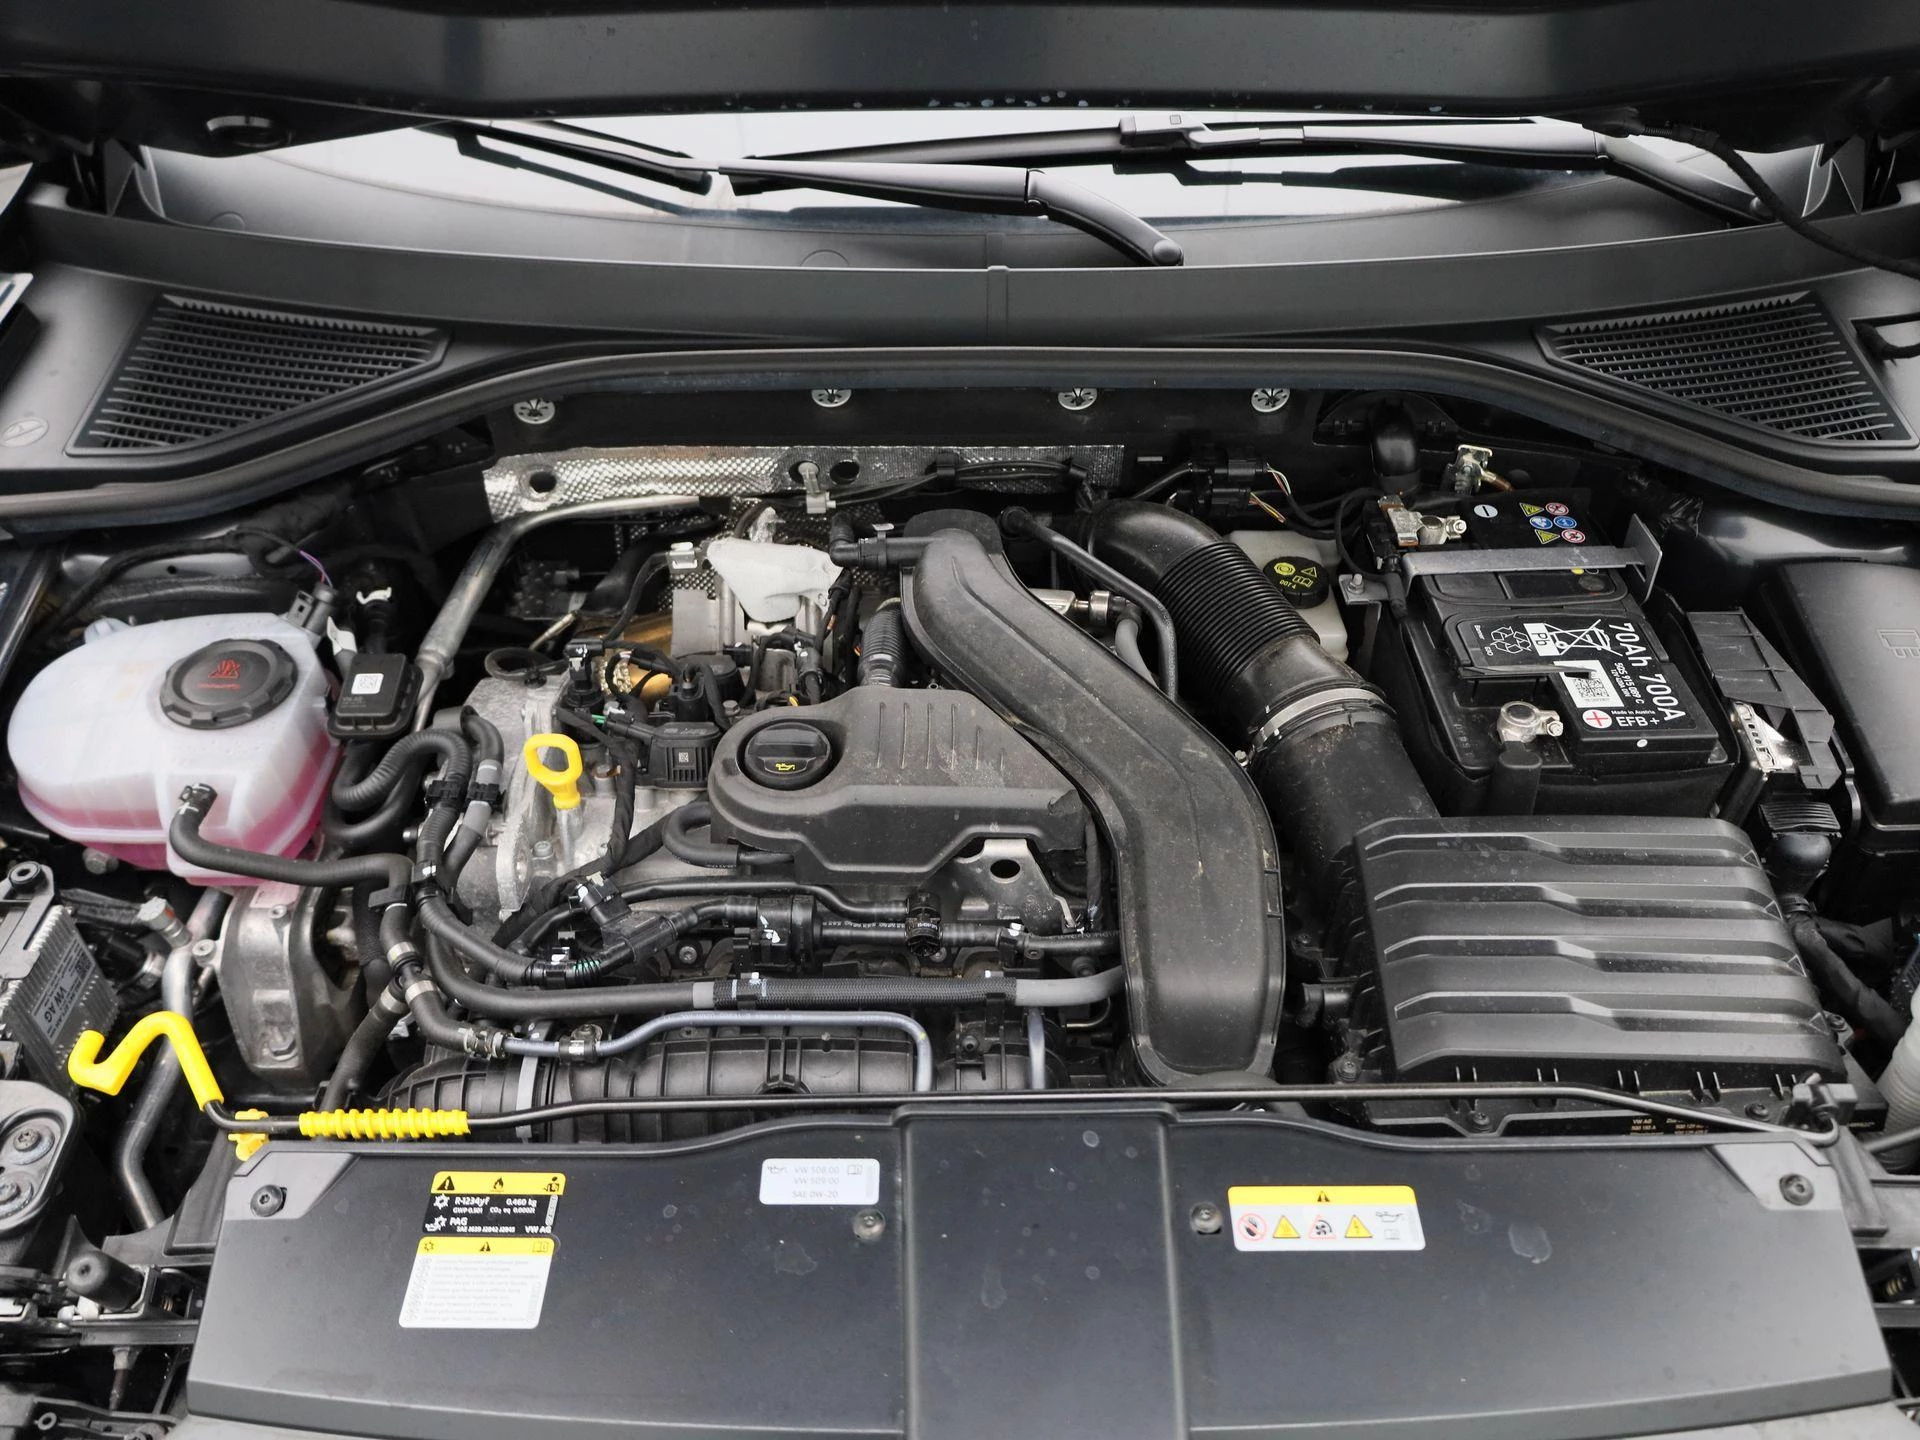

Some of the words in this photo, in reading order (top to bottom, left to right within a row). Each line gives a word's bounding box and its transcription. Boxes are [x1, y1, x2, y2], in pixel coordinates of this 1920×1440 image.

[1531, 632, 1551, 645] Pb
[1608, 622, 1653, 667] 70Ah
[1638, 673, 1686, 721] 700A
[1621, 675, 1635, 686] 915
[1615, 716, 1649, 727] EFB
[53, 986, 67, 1007] VW
[44, 1001, 57, 1023] AG
[454, 1196, 491, 1207] R-1234yf
[449, 1217, 469, 1226] PAG
[524, 1225, 539, 1234] VW
[539, 1225, 552, 1234] AG
